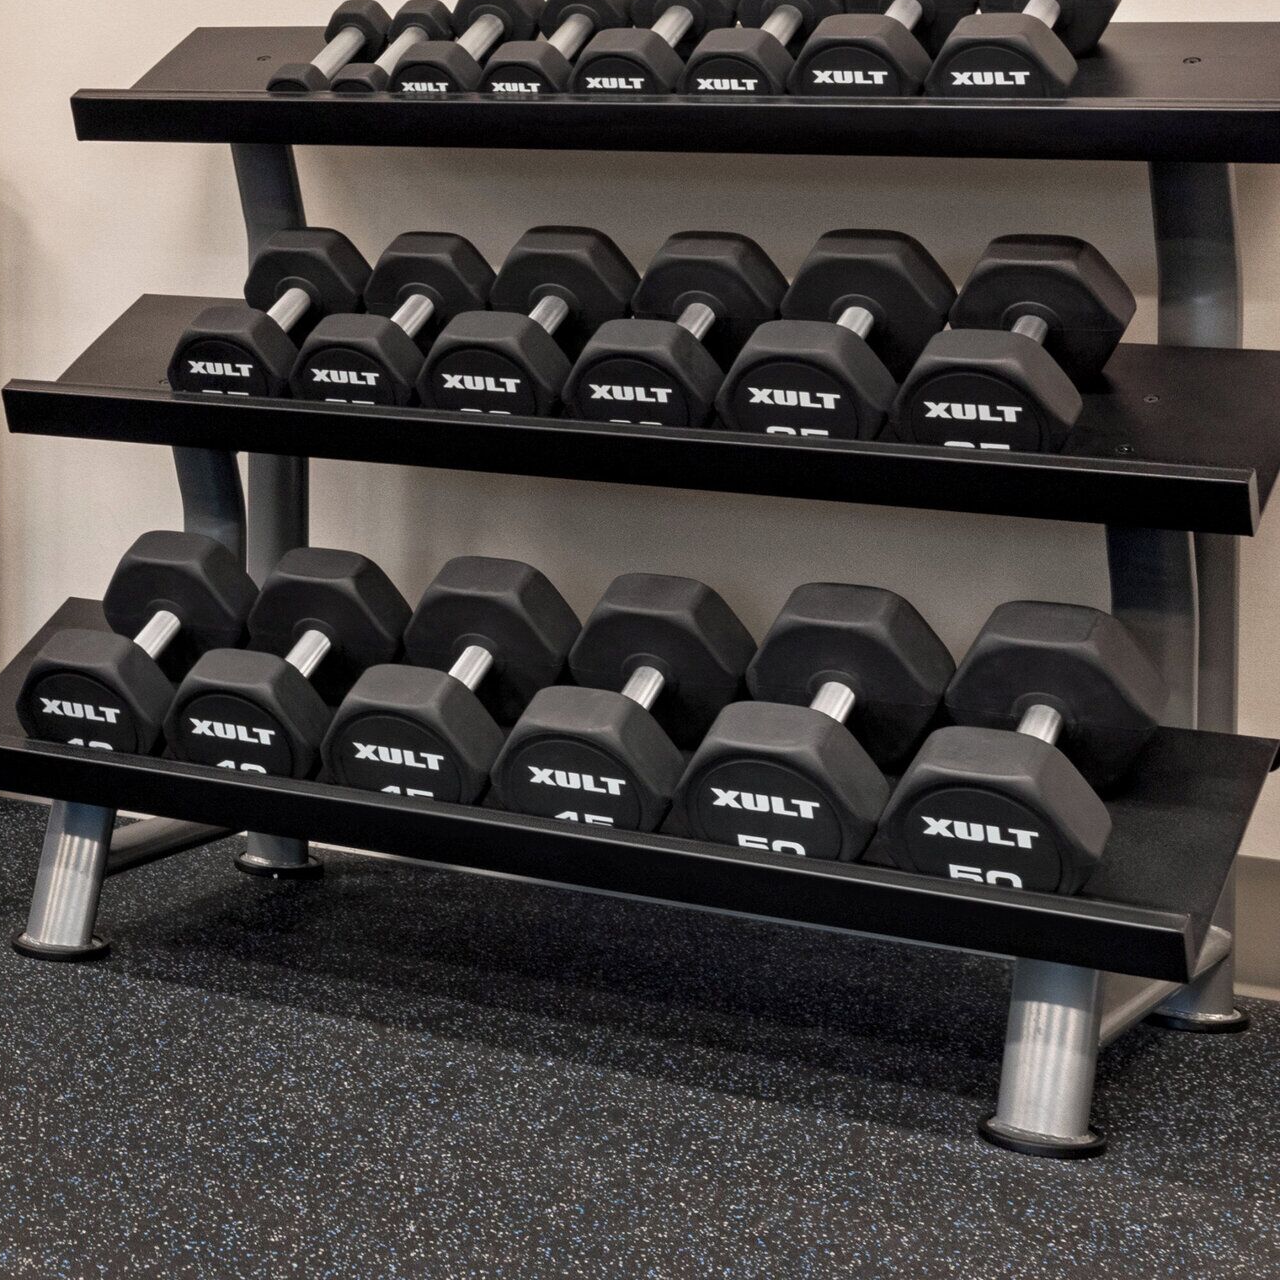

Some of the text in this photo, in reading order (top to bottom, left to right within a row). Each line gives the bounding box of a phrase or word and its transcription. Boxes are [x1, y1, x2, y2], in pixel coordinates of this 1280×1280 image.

[401, 81, 449, 93] XULT
[585, 77, 645, 90] XULT
[696, 78, 759, 91] XULT
[812, 69, 889, 85] XULT
[950, 71, 1031, 86] XULT
[491, 82, 541, 93] XULT
[188, 360, 254, 377] XULT
[310, 368, 380, 386] XULT
[441, 373, 521, 393] XULT
[588, 383, 673, 403] XULT
[747, 387, 841, 410] XULT
[923, 401, 1023, 423] XULT
[39, 697, 121, 724] XULT
[189, 717, 276, 746] XULT
[352, 741, 445, 771] XULT
[527, 765, 627, 796] XULT
[710, 787, 821, 820] XULT
[921, 815, 1040, 850] XULT
